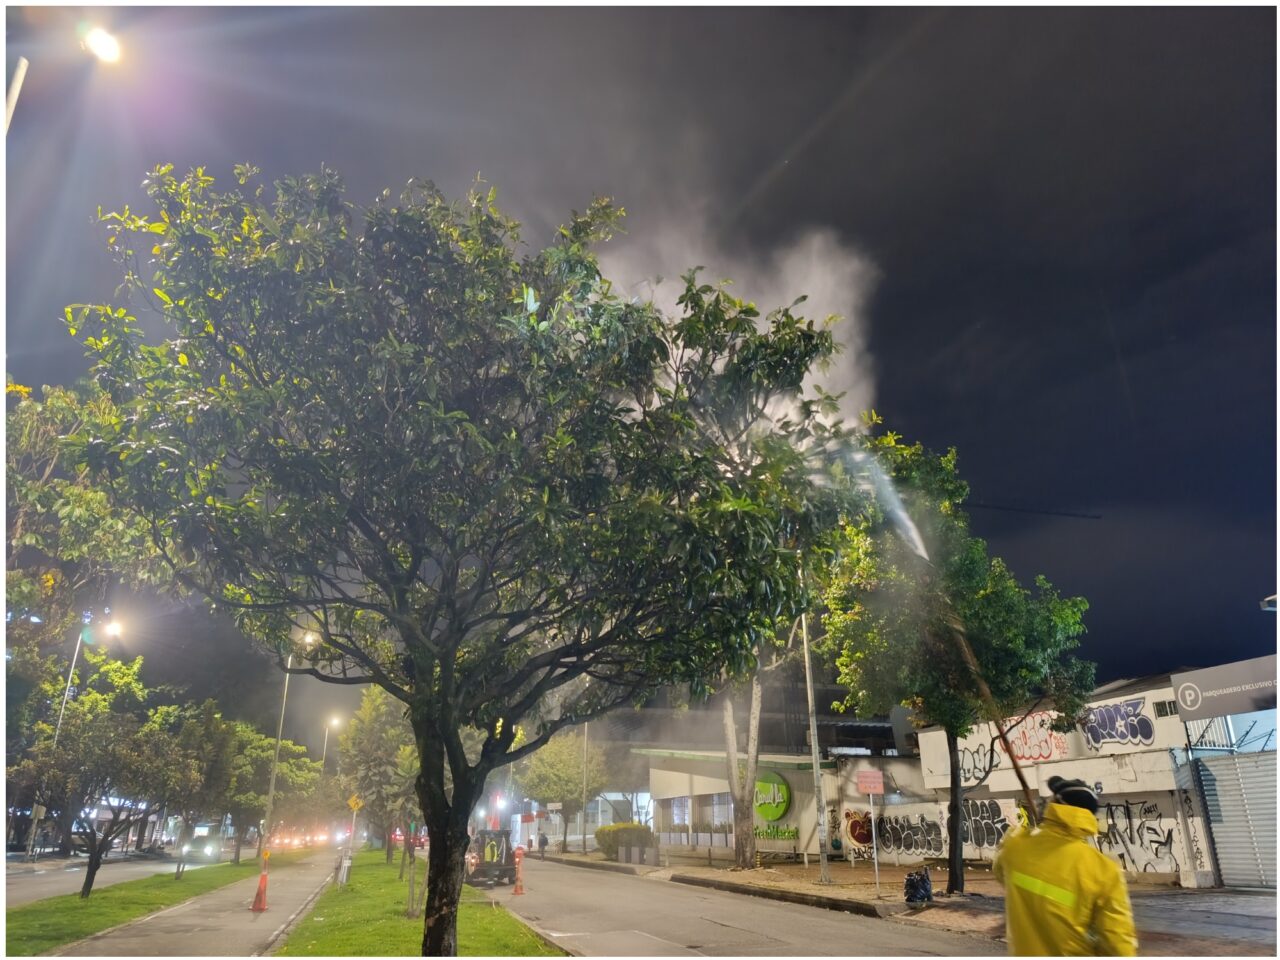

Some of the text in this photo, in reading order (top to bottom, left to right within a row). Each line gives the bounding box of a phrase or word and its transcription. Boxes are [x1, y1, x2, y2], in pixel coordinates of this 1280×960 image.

[1202, 686, 1241, 697] PARQUEADERO
[1242, 680, 1272, 691] EXCLUSIVO
[1184, 690, 1196, 706] P
